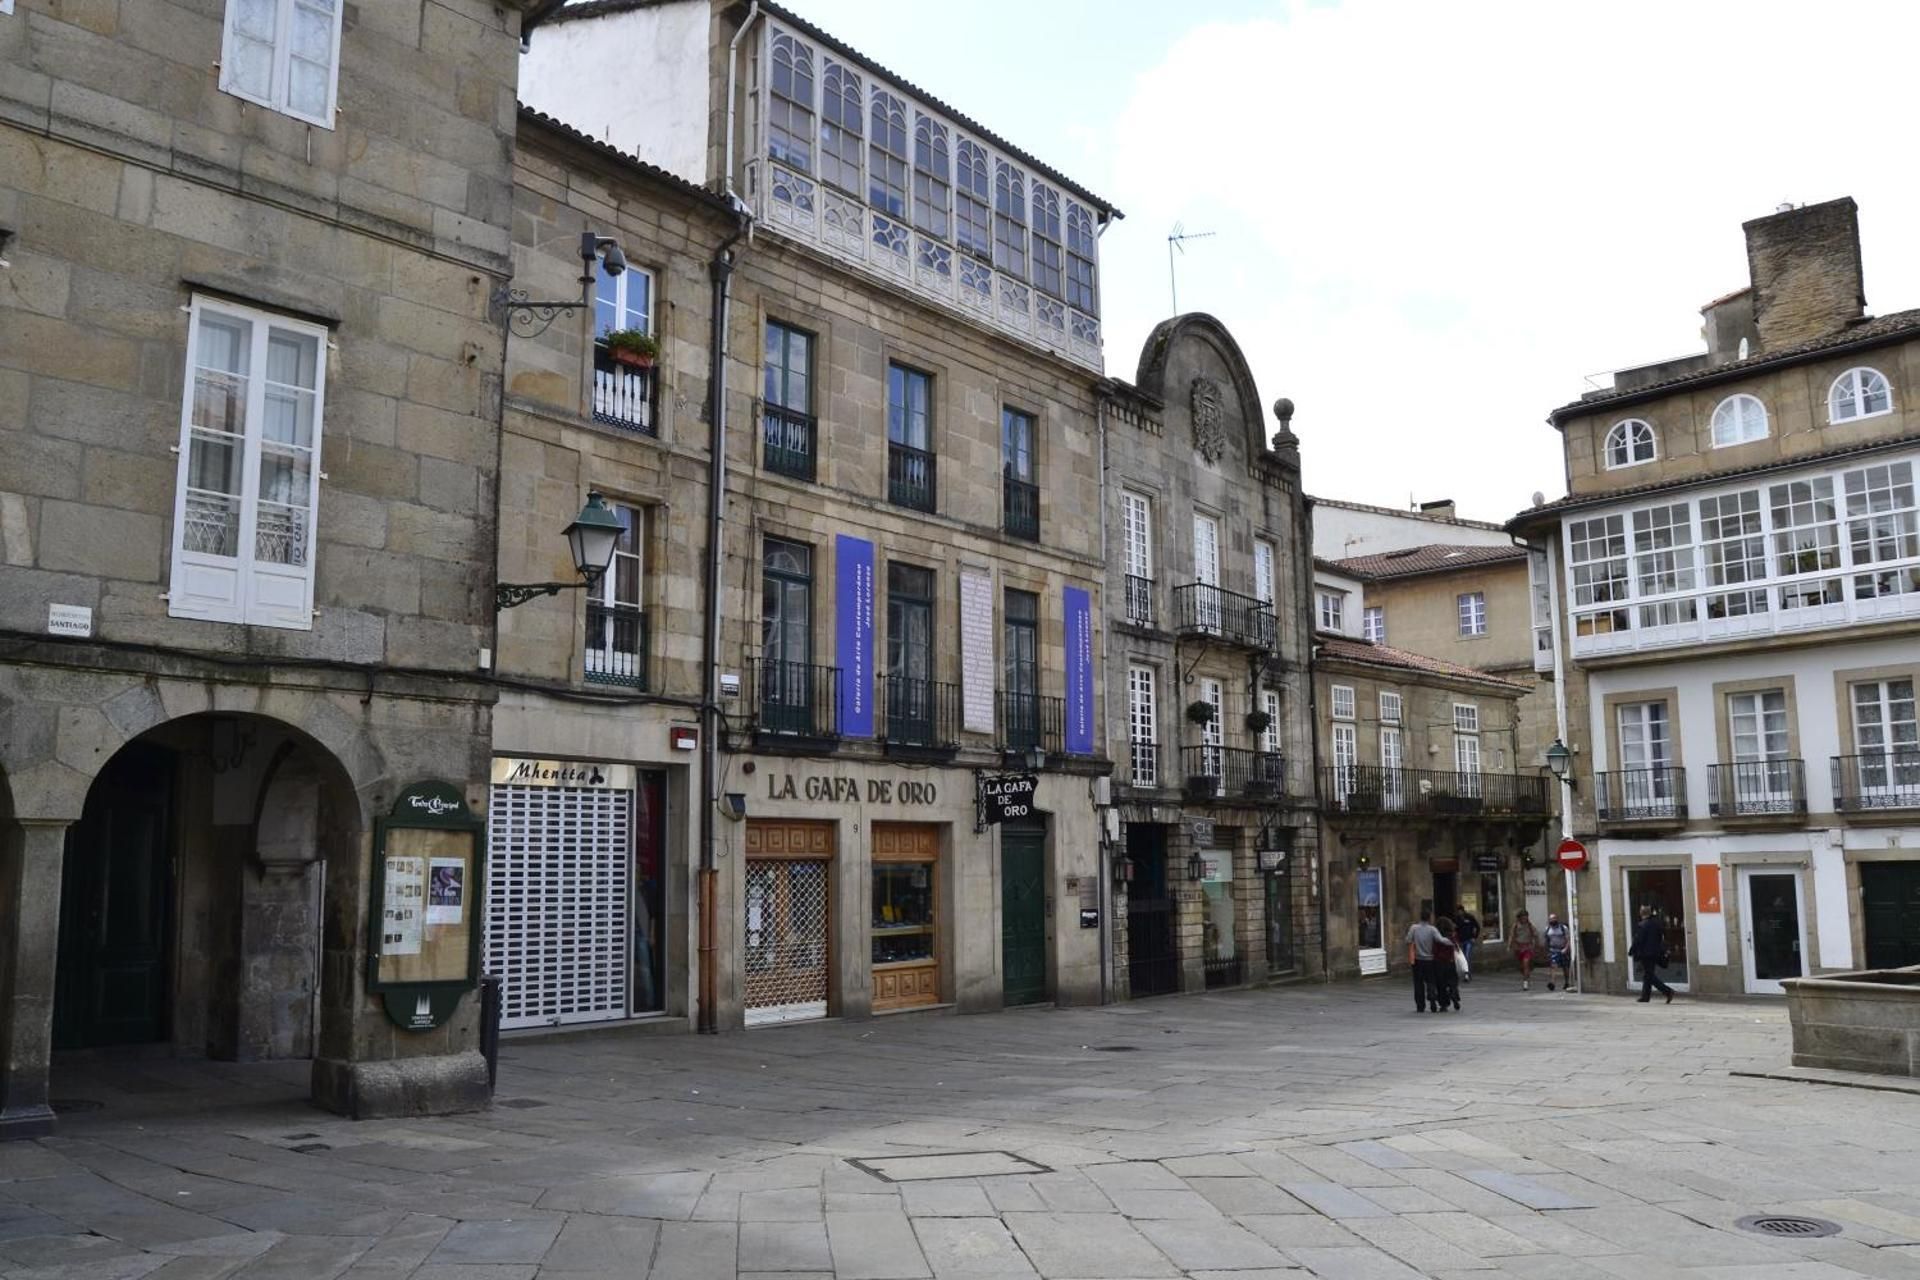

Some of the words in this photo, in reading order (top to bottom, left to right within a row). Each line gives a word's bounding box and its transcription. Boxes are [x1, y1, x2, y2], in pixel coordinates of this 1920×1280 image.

[50, 620, 89, 630] SANTIAGO
[768, 773, 798, 800] LA
[805, 776, 860, 802] GAFA
[867, 779, 892, 804] DE
[898, 781, 937, 805] ORO
[986, 783, 1002, 795] LA
[1003, 781, 1033, 793] GAFA
[997, 795, 1012, 805] DE
[1004, 804, 1028, 817] ORO
[853, 824, 858, 833] 9
